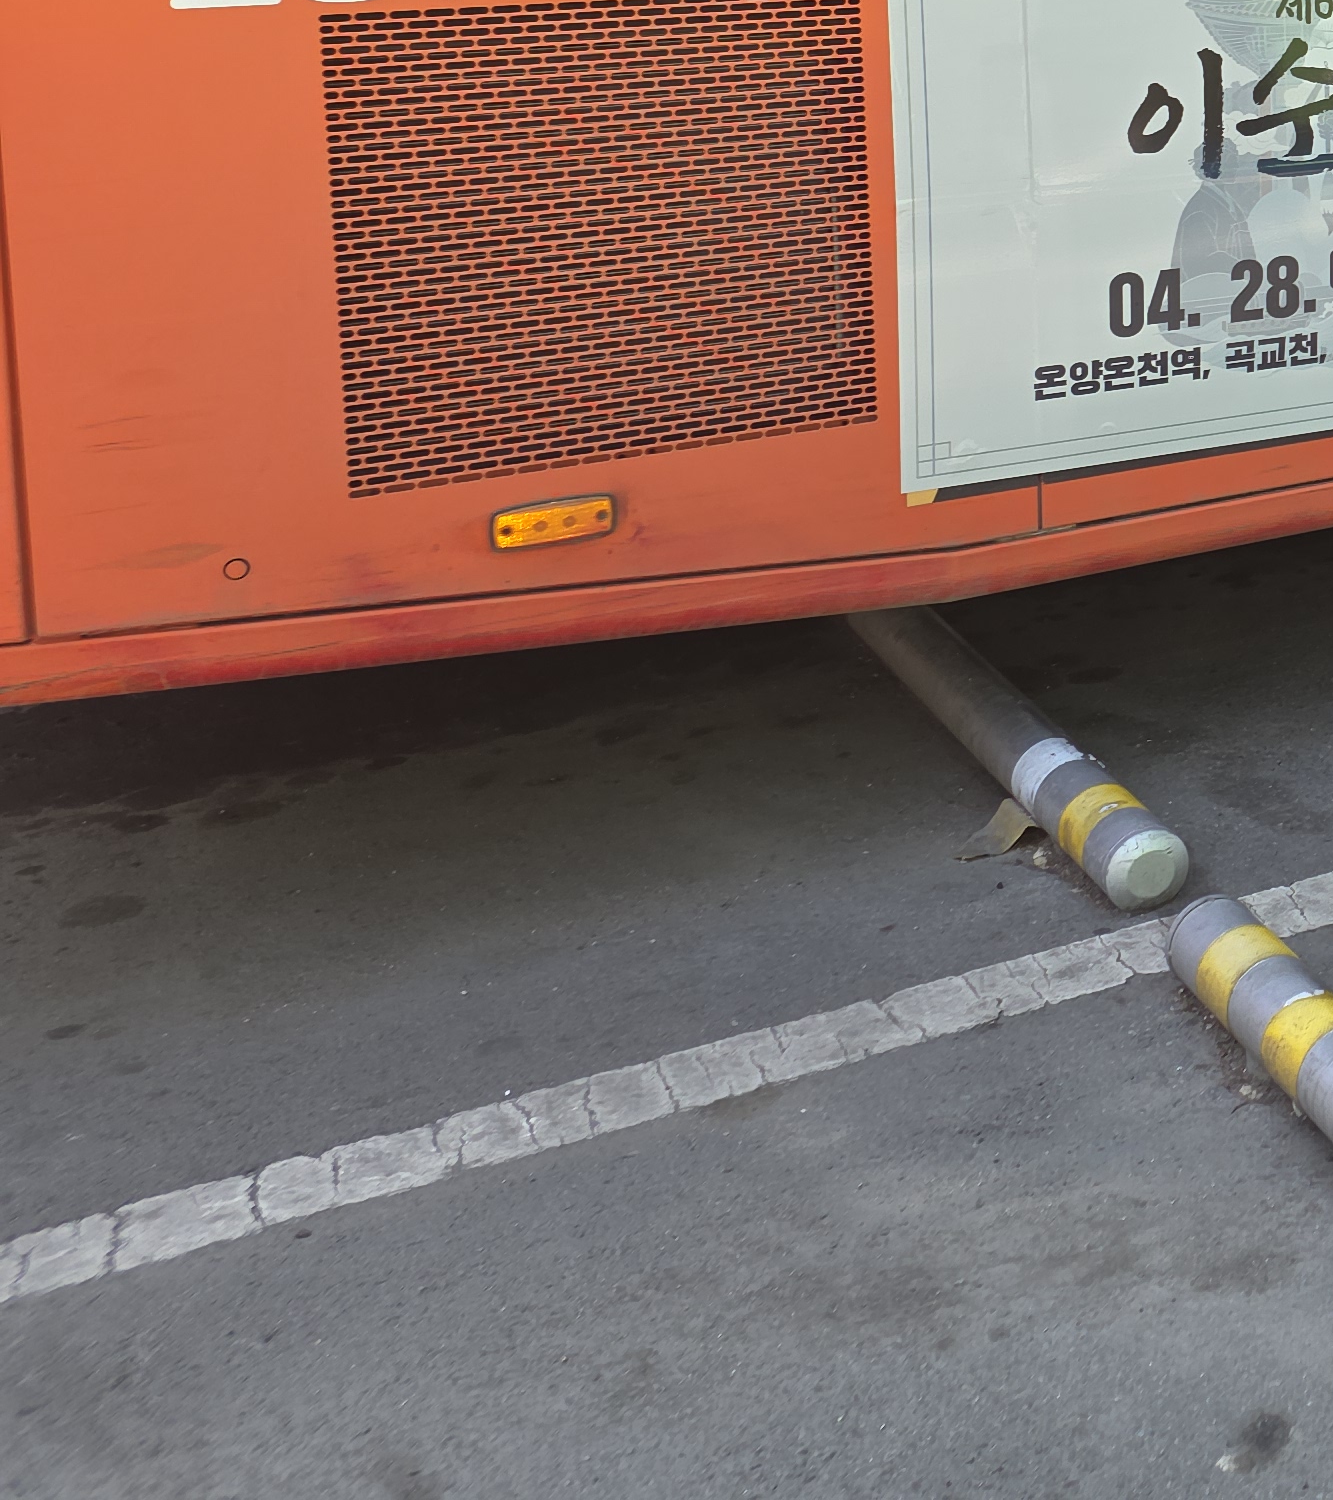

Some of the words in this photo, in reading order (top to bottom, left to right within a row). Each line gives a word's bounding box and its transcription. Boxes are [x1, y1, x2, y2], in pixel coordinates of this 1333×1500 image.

[1109, 270, 1200, 338] 04.
[1230, 255, 1317, 323] 28.
[1033, 347, 1210, 401] 온양온천역,
[1225, 331, 1327, 373] 곡교천,
